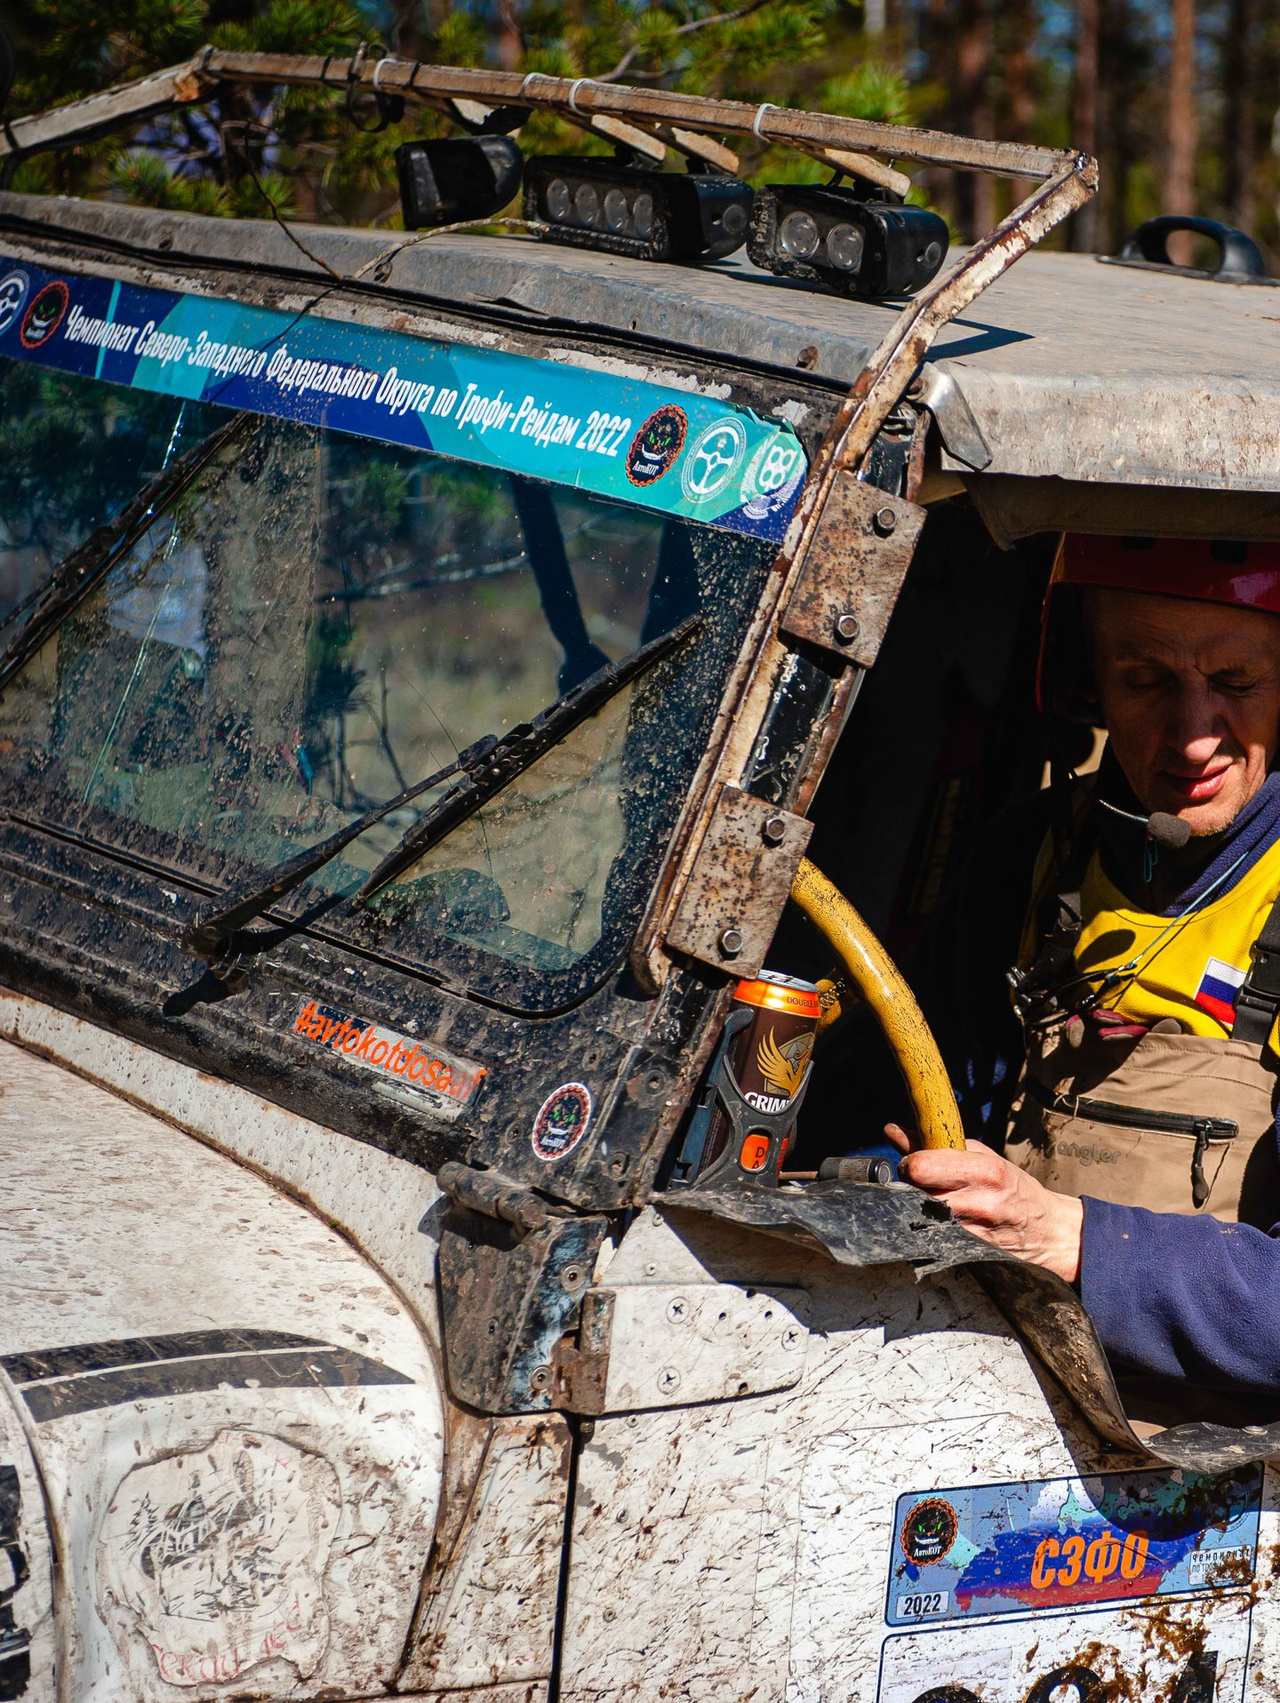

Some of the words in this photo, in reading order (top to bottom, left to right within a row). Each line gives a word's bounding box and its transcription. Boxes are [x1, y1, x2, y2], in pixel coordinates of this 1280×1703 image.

[64, 304, 139, 353] Чемпионат
[135, 320, 268, 379] Северо-Западного
[266, 344, 378, 401] Федерального
[375, 366, 430, 417] Округа
[430, 391, 458, 418] по
[455, 382, 580, 448] Трофи-Рейдам
[574, 409, 632, 459] 2022
[292, 1001, 488, 1099] #avtokotdosaaf
[744, 1091, 790, 1113] GRIM
[1030, 1529, 1148, 1589] СЗФО
[903, 1594, 941, 1615] 2022
